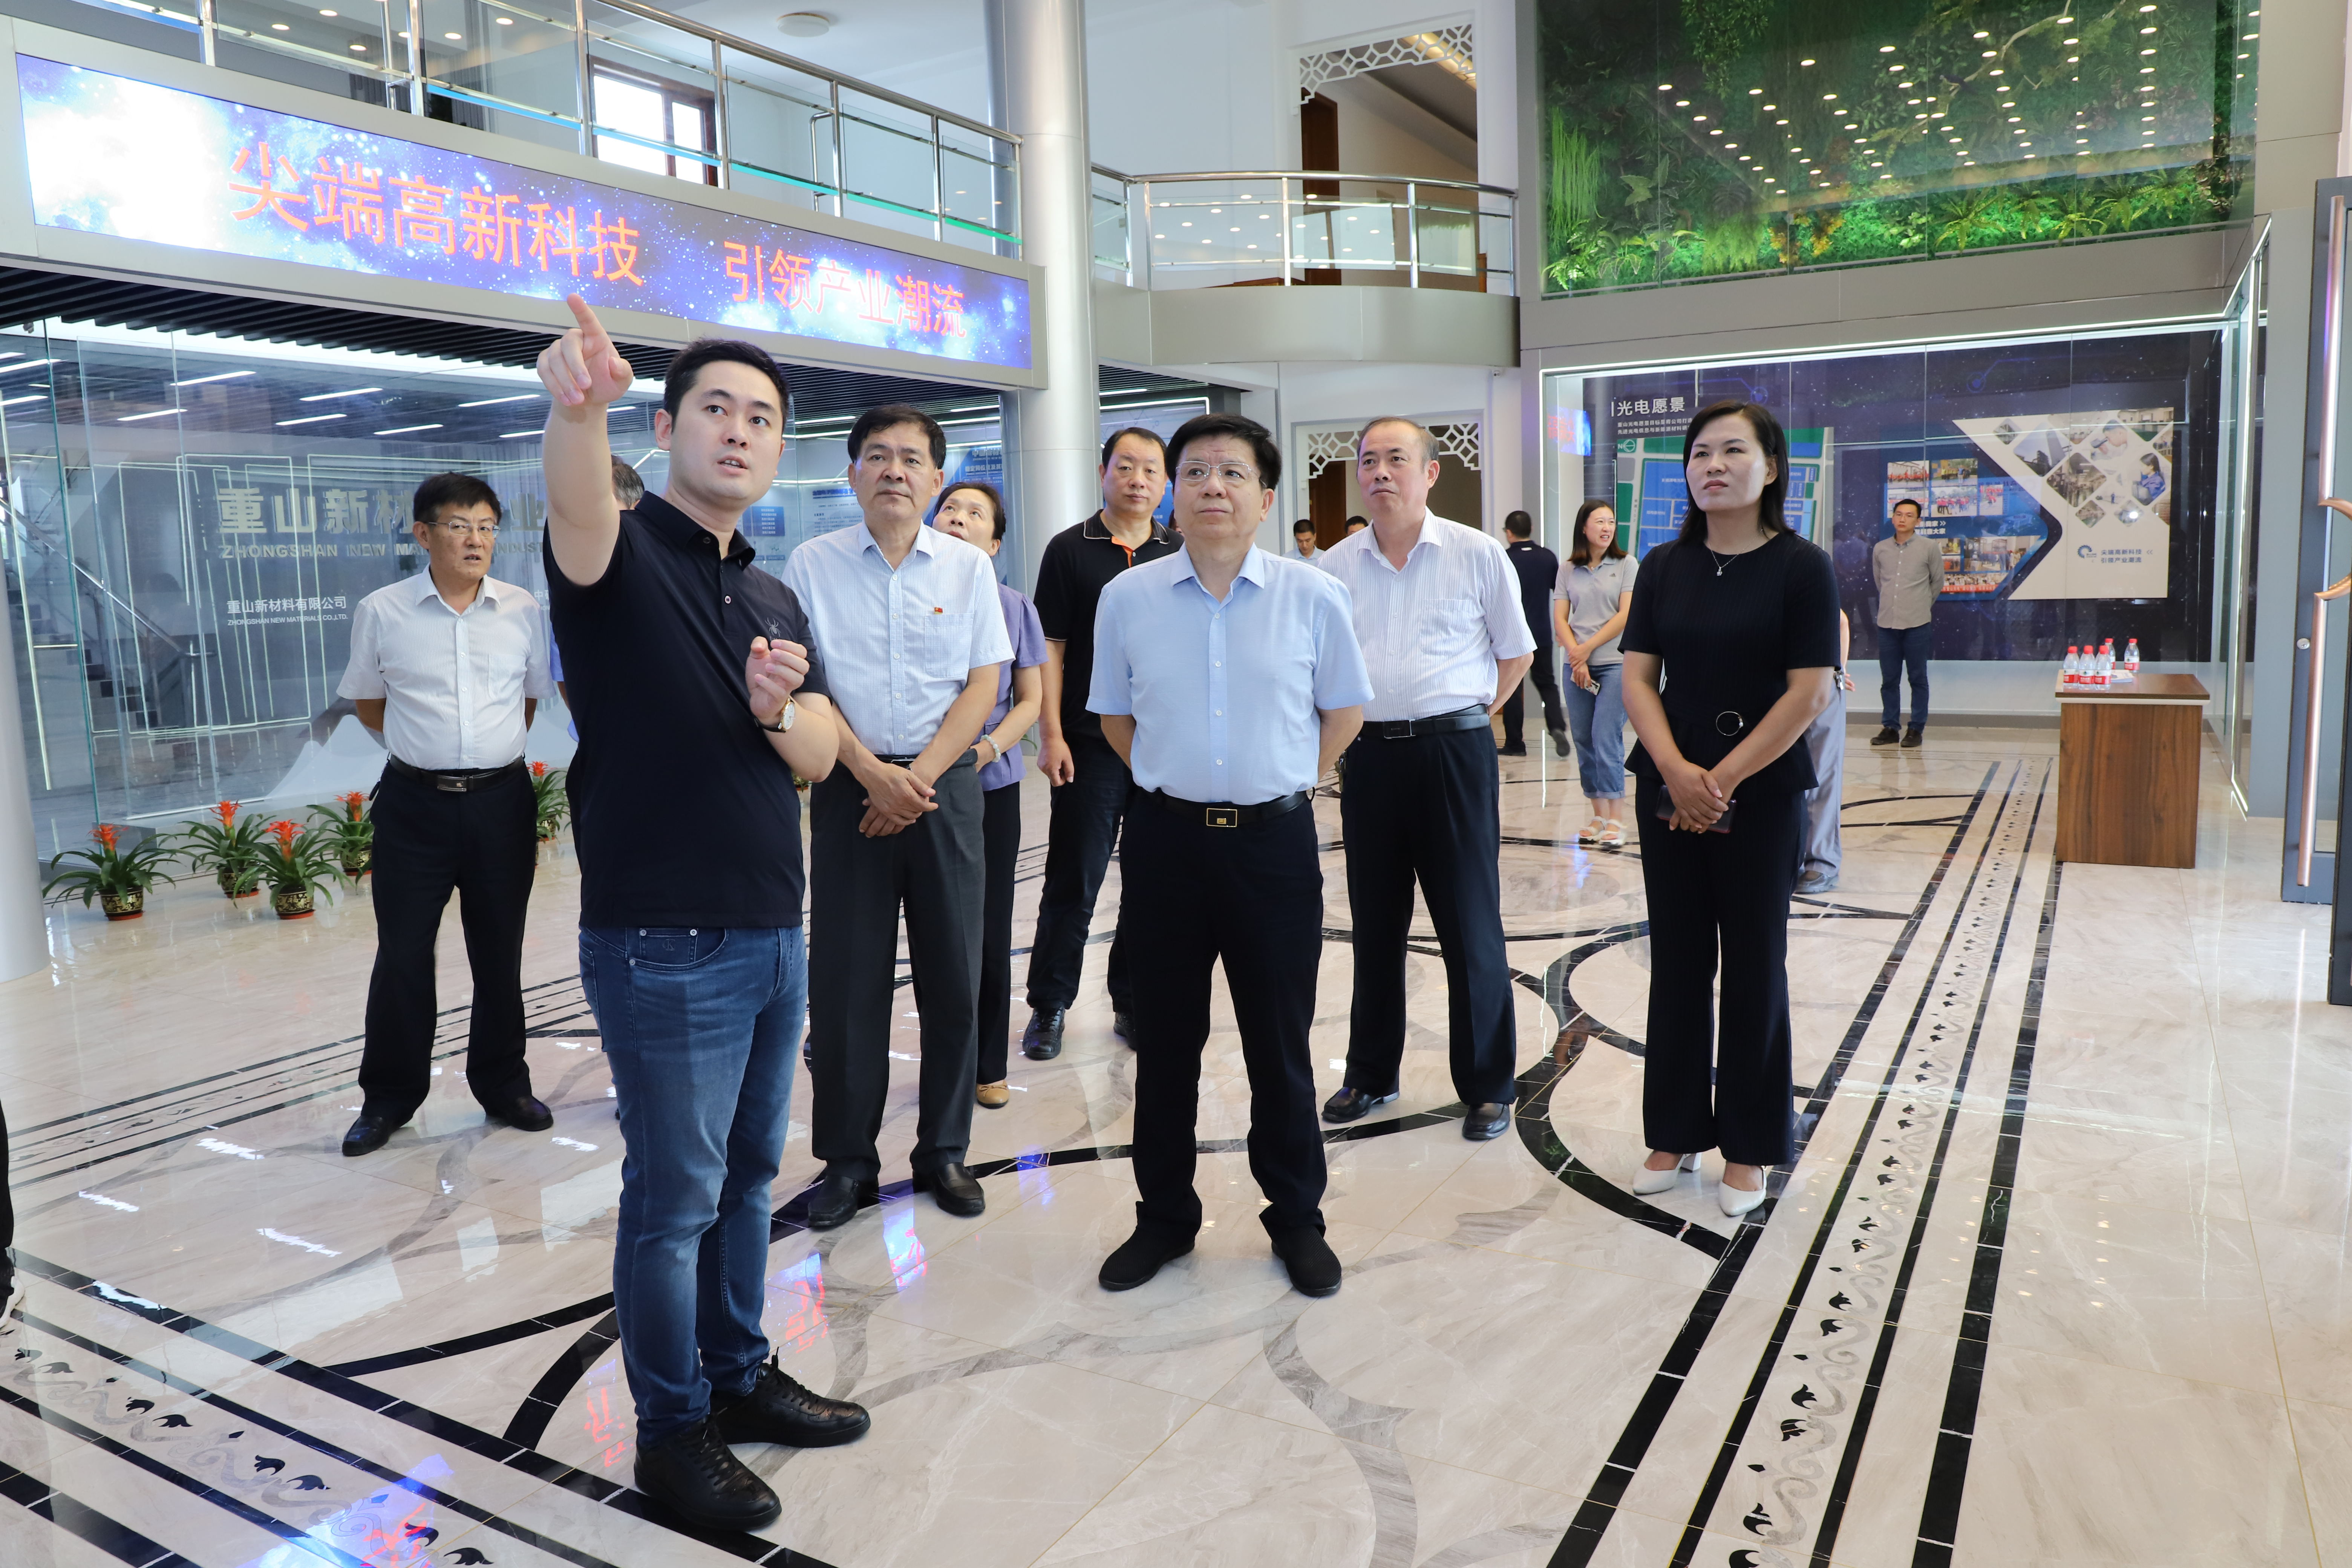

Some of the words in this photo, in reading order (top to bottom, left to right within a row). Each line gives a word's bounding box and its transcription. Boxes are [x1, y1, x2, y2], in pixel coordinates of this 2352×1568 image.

[228, 141, 643, 287] 尖端高新科技
[723, 241, 966, 338] 引领产业潮流
[1617, 397, 1685, 417] 光电愿景
[1617, 425, 1689, 435] 先进光电信息与新能源材料研
[219, 544, 338, 559] ZHONGSHAN
[347, 544, 385, 556] NEW
[227, 596, 347, 614] 重山新材料有限公司
[227, 617, 270, 626] ZHONGSHAN
[286, 615, 322, 623] MATERIALS
